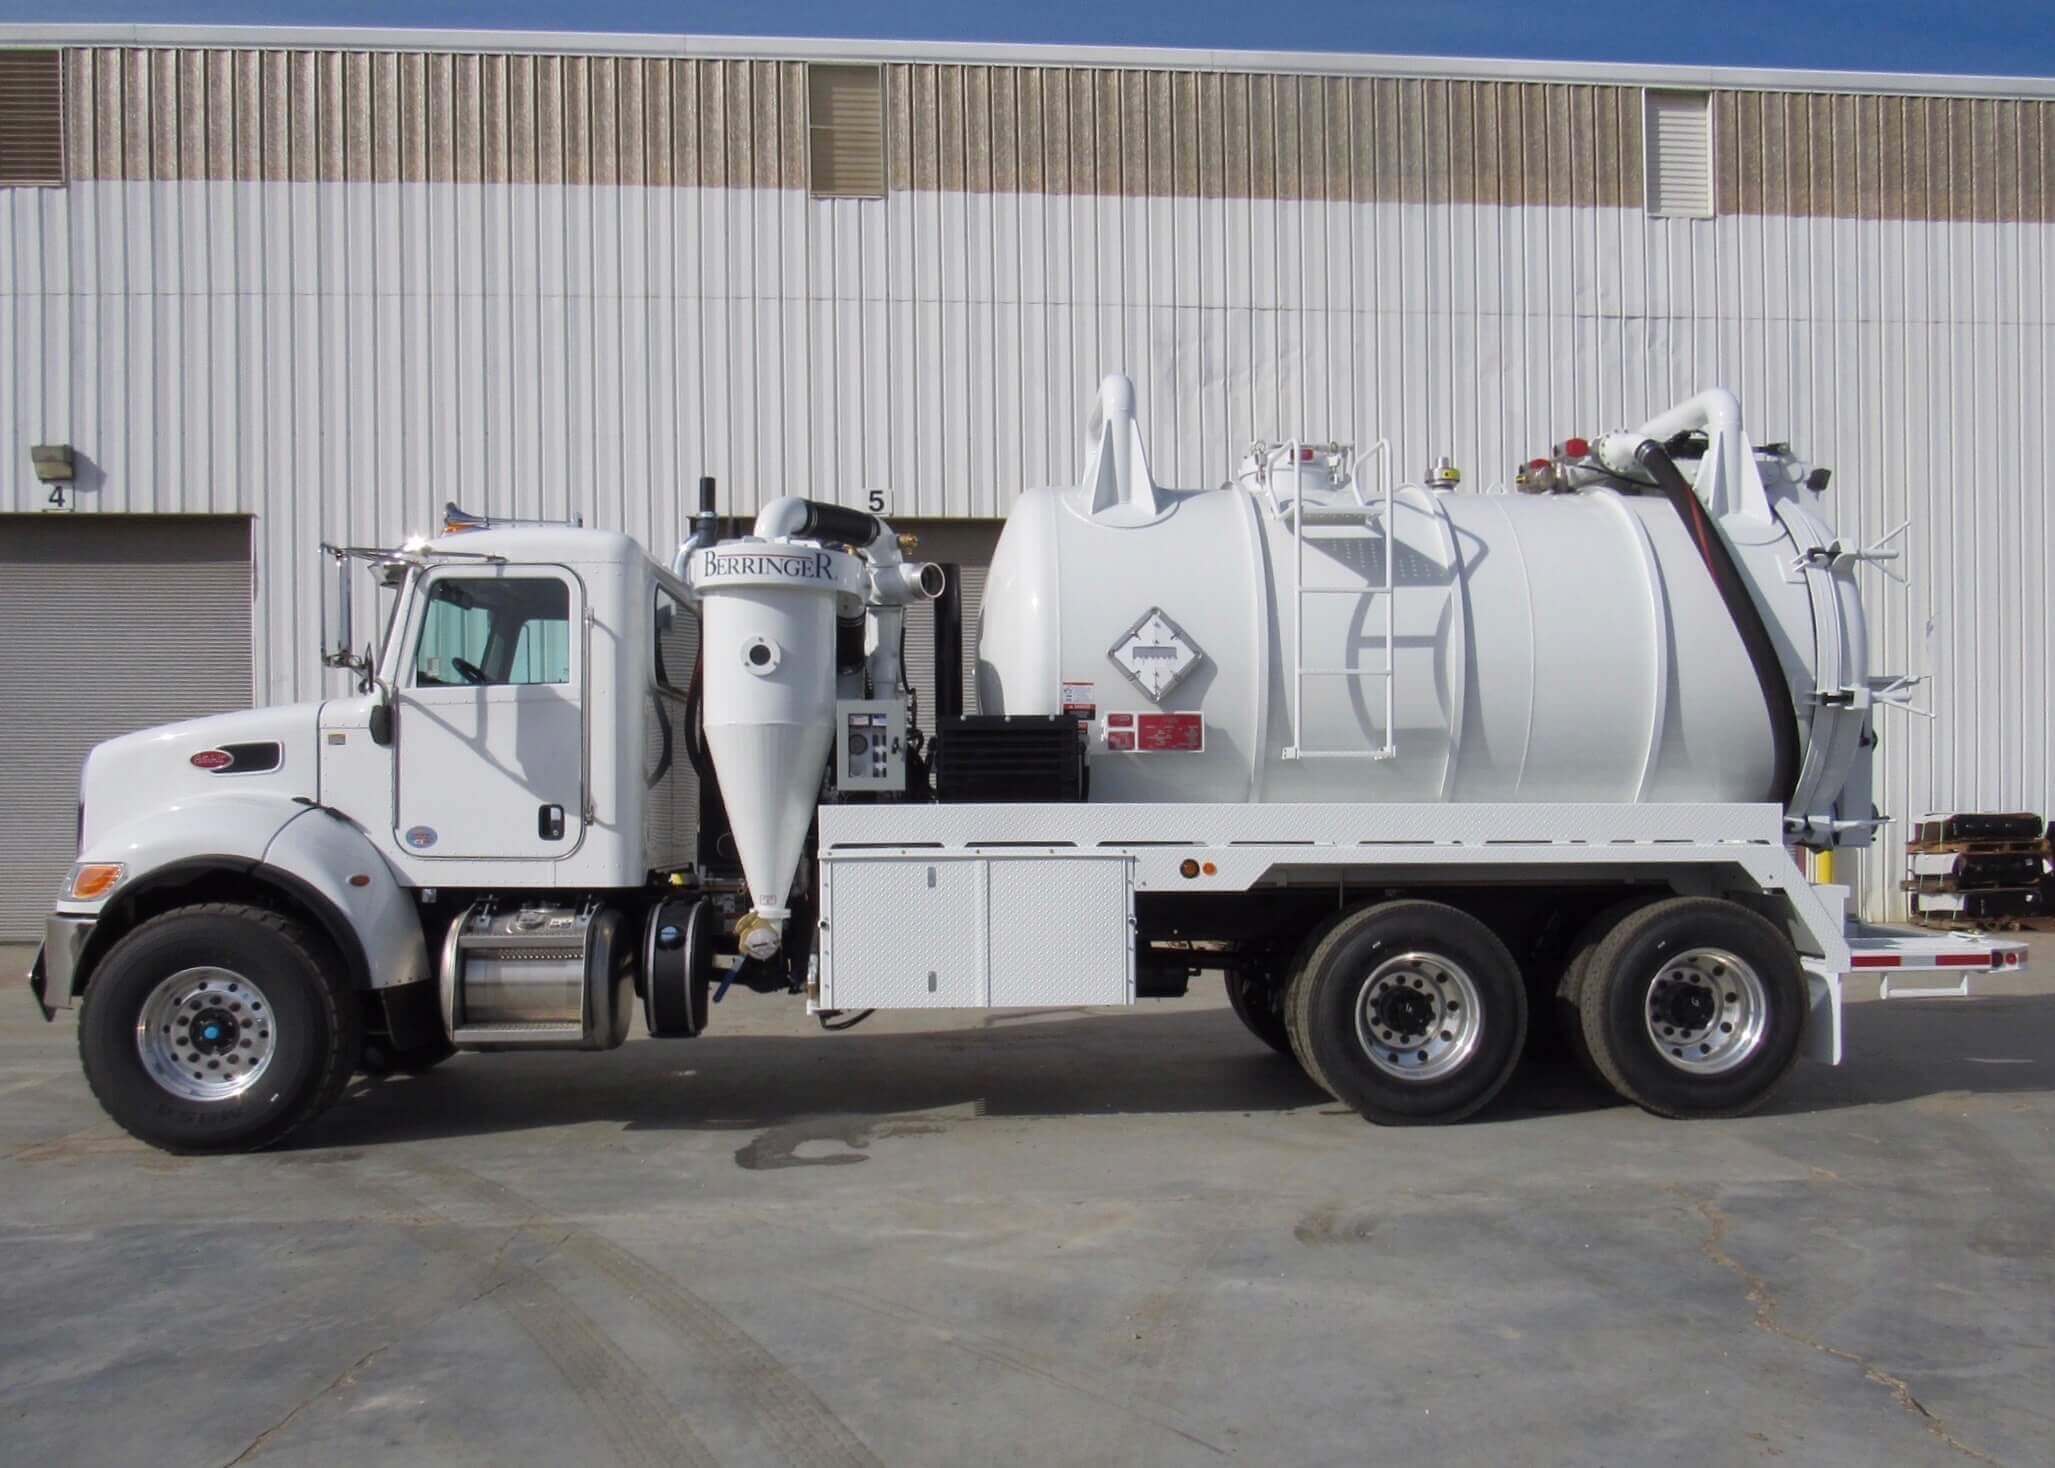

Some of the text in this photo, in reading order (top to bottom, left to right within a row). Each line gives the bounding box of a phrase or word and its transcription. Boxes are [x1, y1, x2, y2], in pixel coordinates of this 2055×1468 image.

[48, 486, 66, 507] 4
[869, 490, 884, 512] 5
[704, 551, 832, 581] BERRINGER
